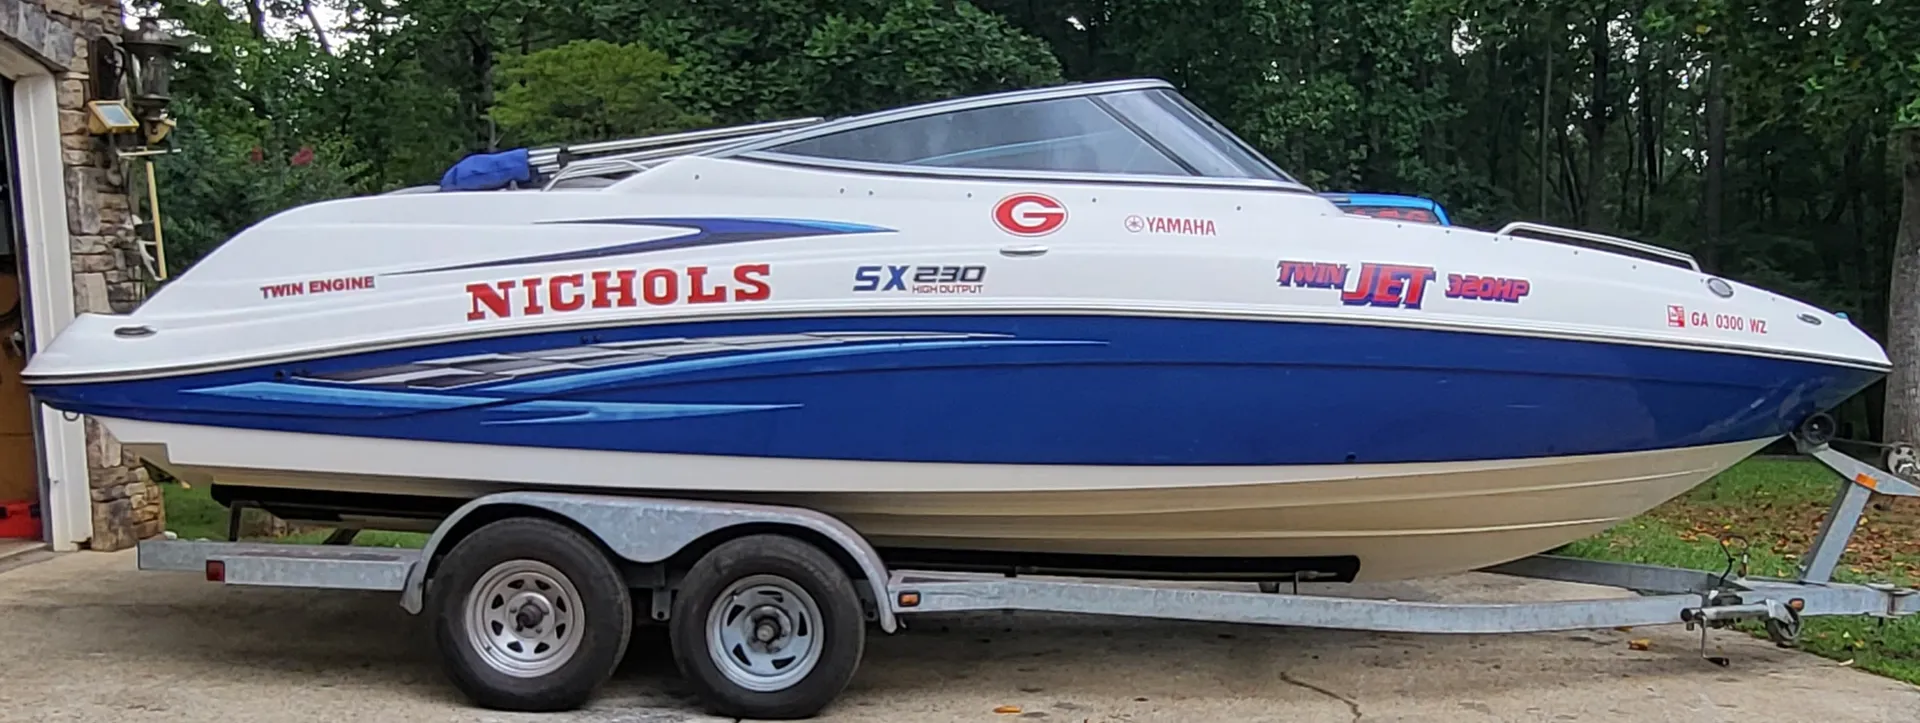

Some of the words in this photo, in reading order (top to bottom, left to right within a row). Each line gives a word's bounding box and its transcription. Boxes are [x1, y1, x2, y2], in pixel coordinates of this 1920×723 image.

[995, 196, 1066, 234] G
[1145, 216, 1217, 237] YAMAHA
[259, 282, 304, 299] TWIN
[308, 275, 376, 293] ENGINE
[853, 265, 911, 292] SX
[913, 266, 986, 282] 230
[912, 284, 938, 294] HIGH
[939, 284, 984, 294] OUTPUT
[1277, 260, 1350, 290] TWIN
[1340, 262, 1436, 310] JET
[1444, 273, 1531, 304] 320HP
[466, 264, 771, 321] NICHOLS
[1691, 312, 1709, 327] GA
[1716, 314, 1744, 331] 0300
[1749, 318, 1768, 334] WZ
